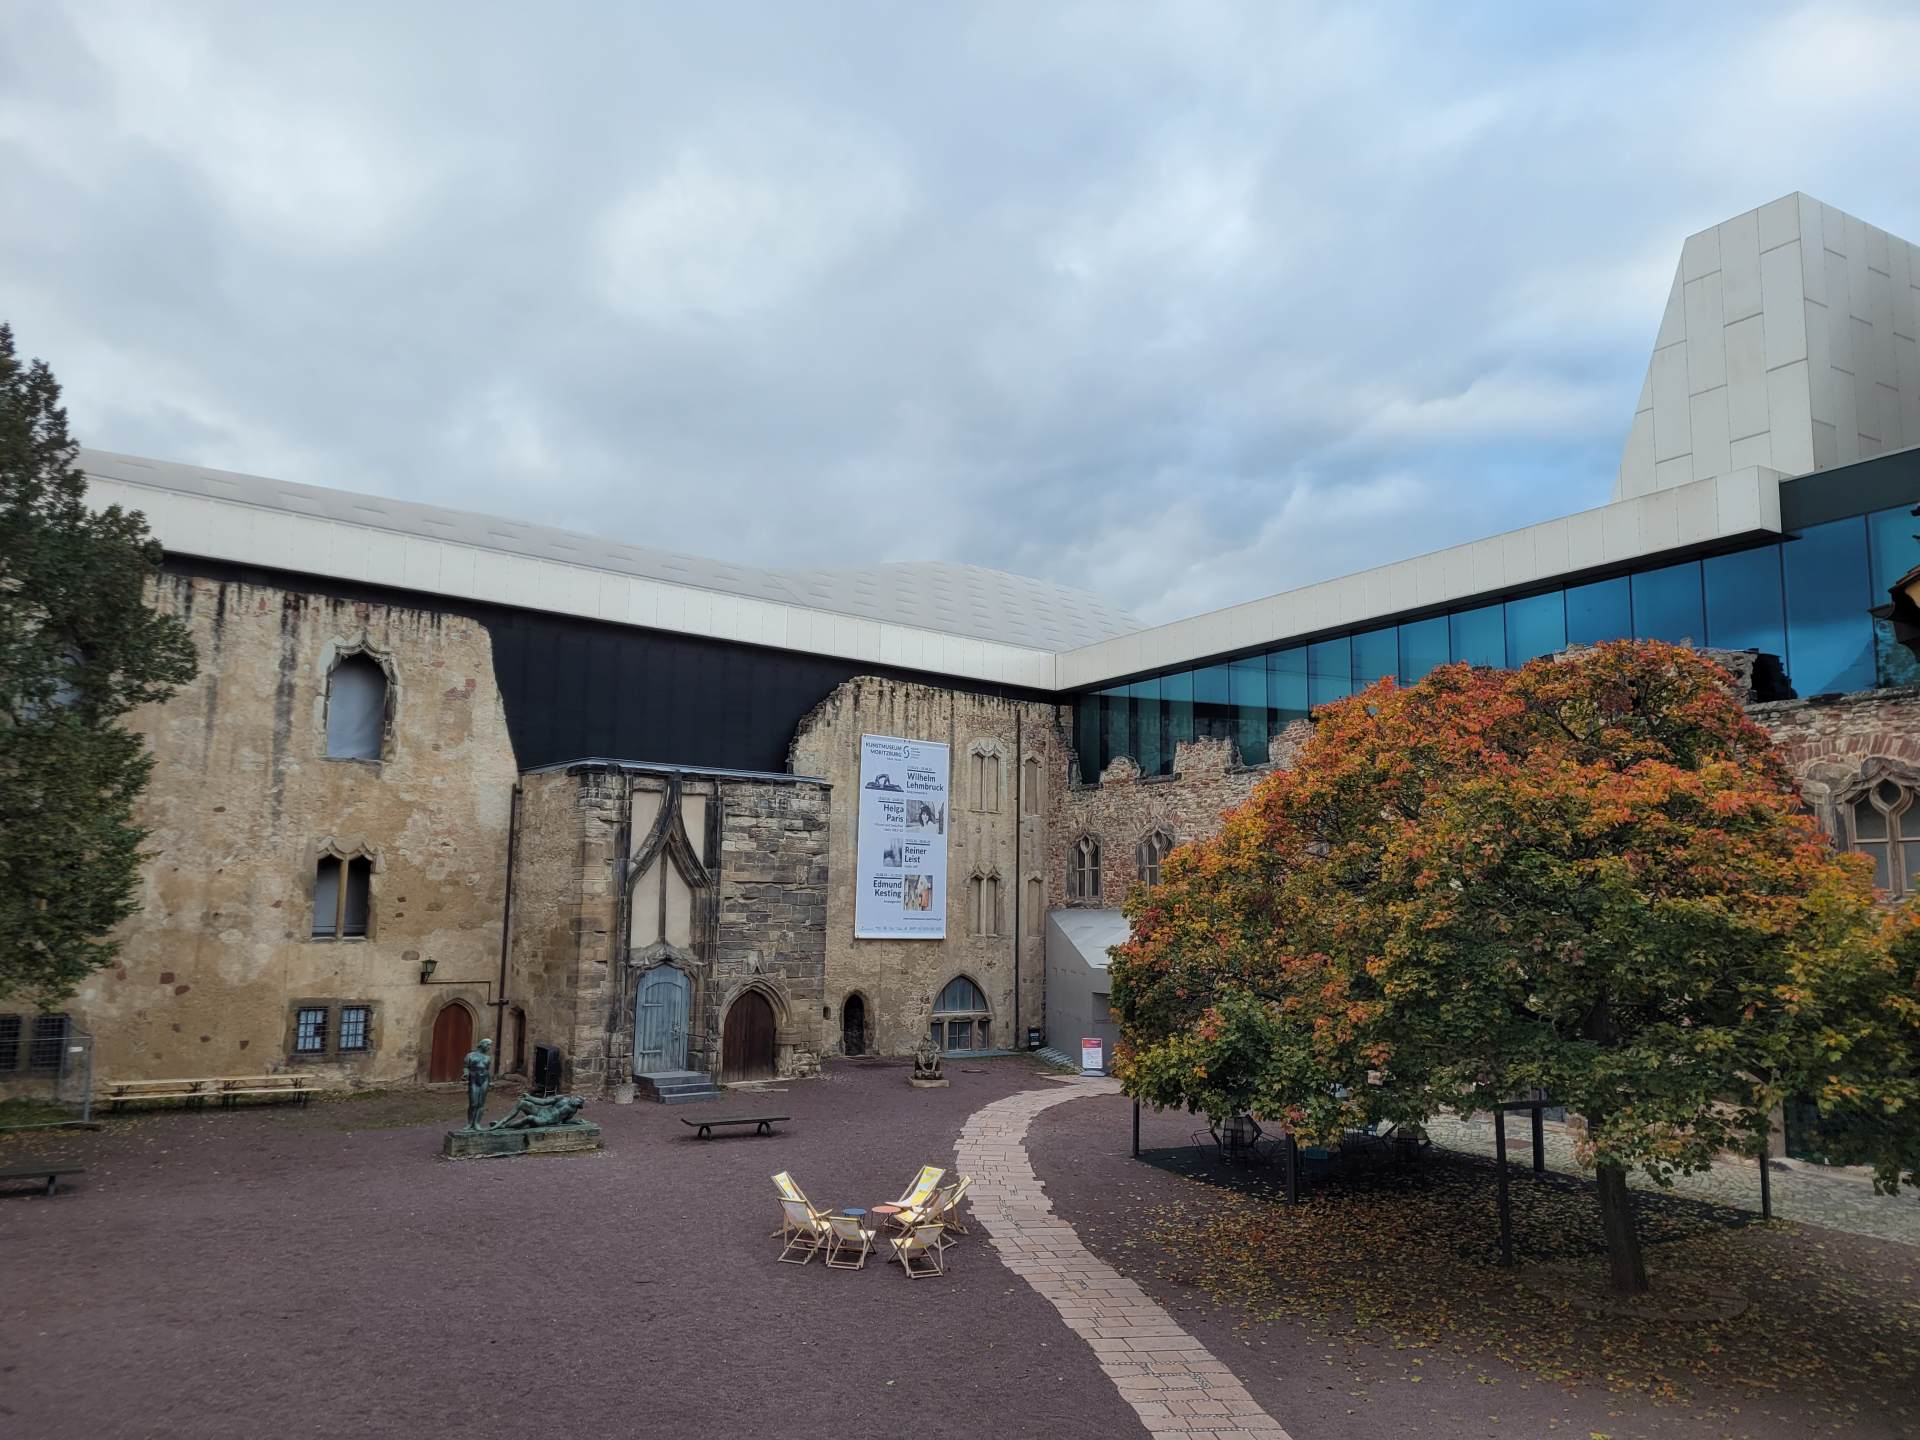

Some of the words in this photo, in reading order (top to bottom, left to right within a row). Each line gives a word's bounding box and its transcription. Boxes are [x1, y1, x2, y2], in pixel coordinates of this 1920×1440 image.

[907, 773, 936, 782] Wilhelm
[906, 781, 944, 791] Lehmbruck
[883, 804, 904, 814] Helga
[886, 814, 904, 822] Paris
[904, 846, 927, 854] Reiner
[904, 855, 920, 863] Leist
[873, 880, 902, 889] Edmund
[874, 889, 902, 898] Kesting
